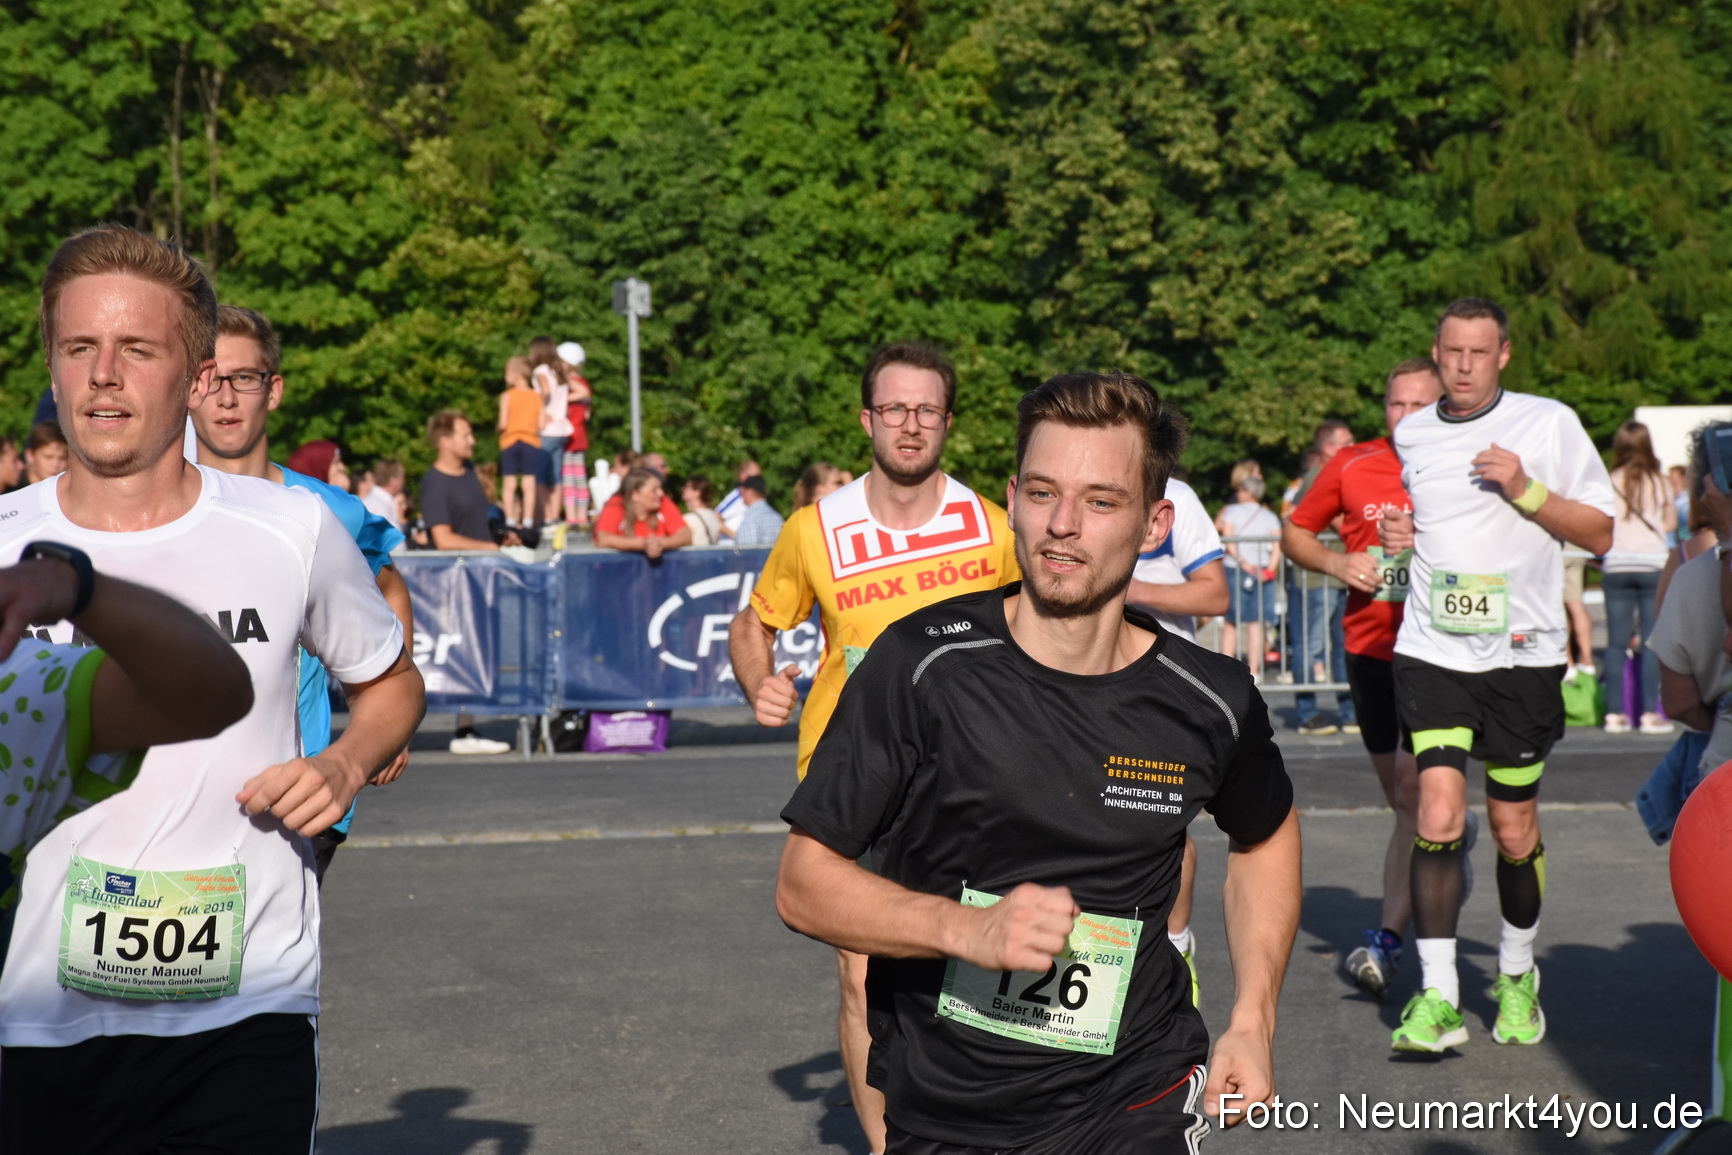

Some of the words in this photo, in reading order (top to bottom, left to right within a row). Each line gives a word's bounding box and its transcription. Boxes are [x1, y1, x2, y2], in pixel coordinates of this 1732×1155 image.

[835, 576, 908, 612] MAX
[916, 558, 996, 592] BÖGL
[1383, 567, 1410, 586] 60
[1445, 594, 1490, 616] 694
[941, 621, 972, 635] JAKO
[1109, 755, 1186, 773] BERSCHNEIDER
[1107, 768, 1185, 785] BERSCHNEIDER
[1105, 785, 1163, 800] ARCHITEKTEN
[1168, 792, 1183, 802] BDA
[1104, 798, 1182, 815] INNENARCHITEKTEN
[92, 887, 164, 909] firmenlauf
[203, 900, 234, 915] 2019
[85, 910, 220, 964] 1504
[96, 959, 148, 976] Nunner
[152, 964, 202, 978] Manuel
[1094, 953, 1124, 966] 2019
[67, 965, 91, 978] Magna
[92, 970, 112, 982] Steyr
[113, 975, 131, 984] Fuel
[132, 976, 166, 986] Systems
[168, 976, 192, 986] GmbH
[193, 975, 230, 985] Neumarkt
[949, 999, 1011, 1023] Berschneider
[1020, 1018, 1081, 1039] Berschneider
[1082, 1030, 1108, 1041] GmbH
[992, 997, 1030, 1016] Baier
[1032, 1007, 1075, 1025] Martin
